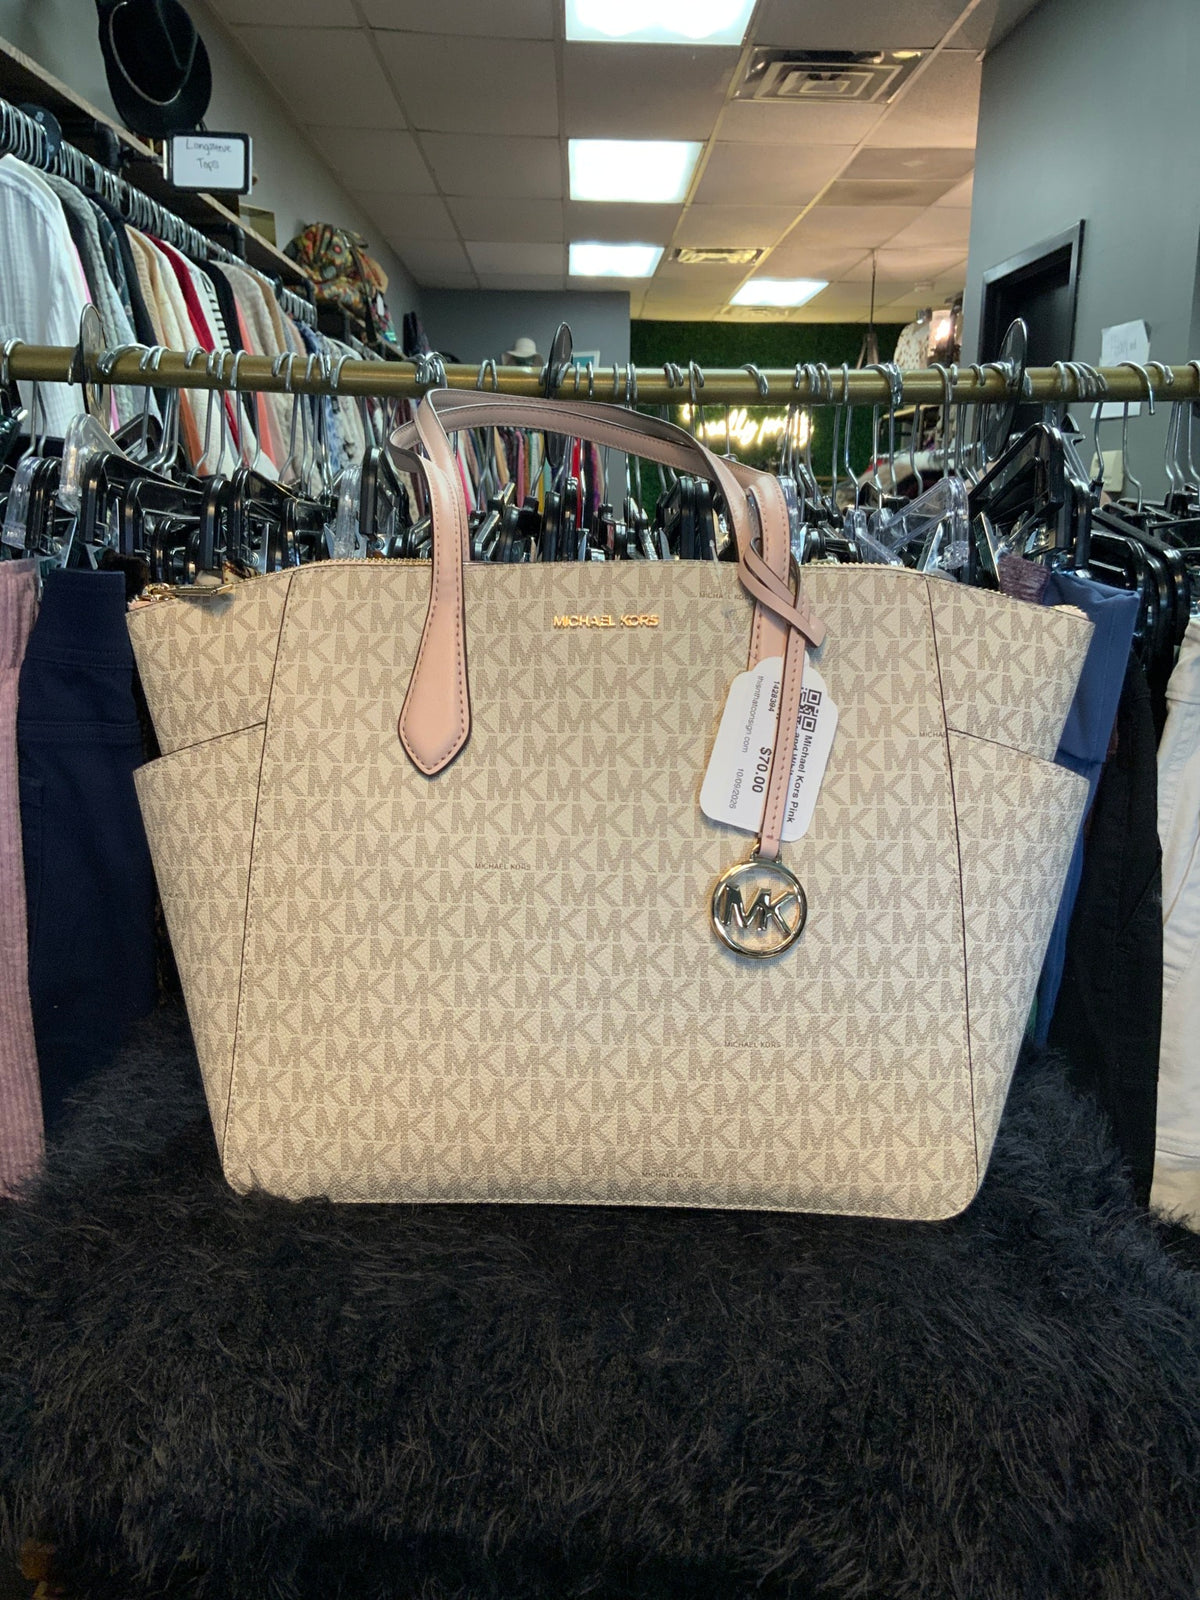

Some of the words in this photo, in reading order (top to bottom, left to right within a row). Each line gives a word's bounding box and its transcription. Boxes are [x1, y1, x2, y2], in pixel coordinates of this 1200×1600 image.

[553, 615, 616, 628] MICHAEL
[620, 614, 660, 628] KORS
[768, 681, 780, 712] 1428394
[742, 675, 764, 753] thisnthatconsign.com
[798, 735, 813, 773] Michael
[752, 746, 773, 793] $70.00
[792, 775, 804, 799] Kors
[786, 801, 799, 823] Pink
[510, 863, 531, 871] KORS
[720, 882, 796, 937] MK
[760, 1041, 782, 1049] KORS
